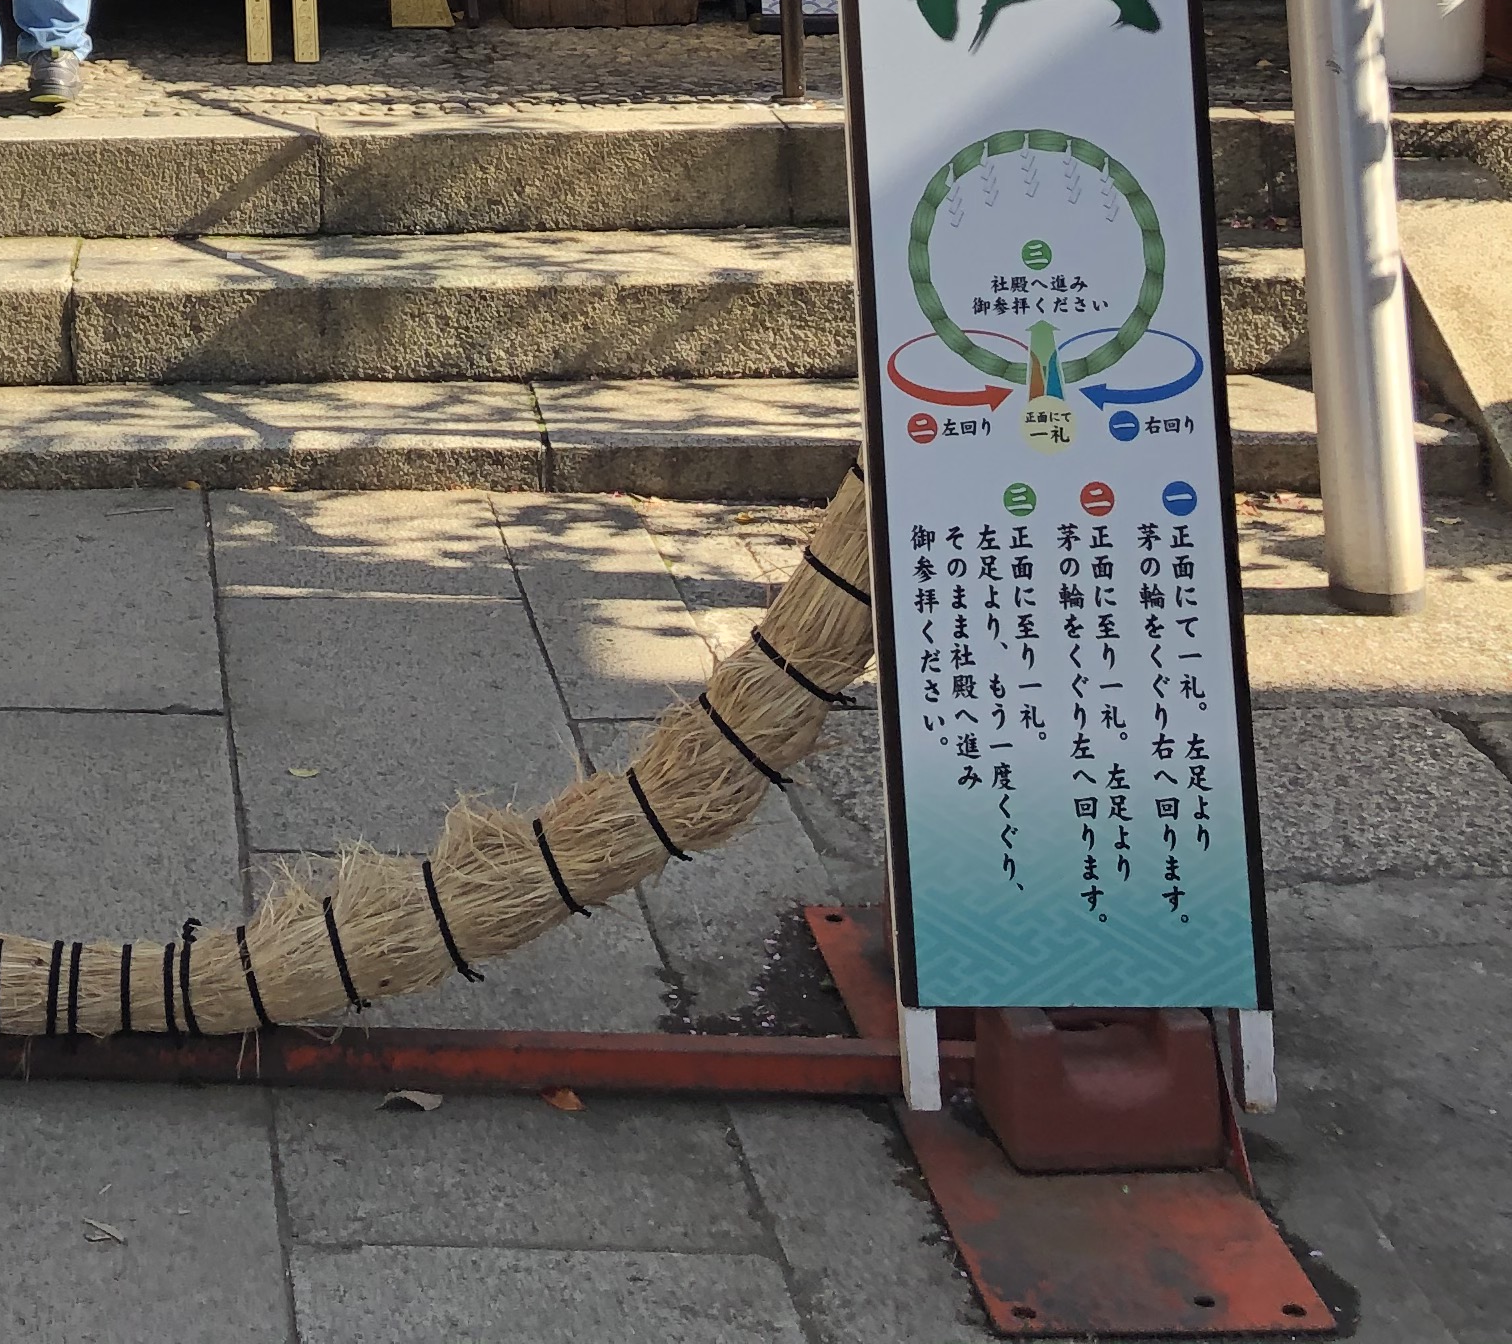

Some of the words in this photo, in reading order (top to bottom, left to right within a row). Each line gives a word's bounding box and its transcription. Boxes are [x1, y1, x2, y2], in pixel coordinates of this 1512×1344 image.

[990, 275, 1089, 294] 社殿へ進み
[972, 296, 1110, 315] 御参拝ください
[941, 416, 992, 437] 左回り
[1025, 411, 1071, 424] 正面にて
[1144, 414, 1195, 435] 右回り
[1029, 424, 1071, 443] 一礼
[910, 524, 949, 747] 御参拝ください。
[1008, 526, 1047, 742] 正面に至り一礼。
[945, 526, 983, 791] そのまま社殿へ進み
[1057, 523, 1108, 923] 茅の輪をくぐり左へ回ります。
[1137, 523, 1189, 923] 茅の輪をくぐり右へ回ります。
